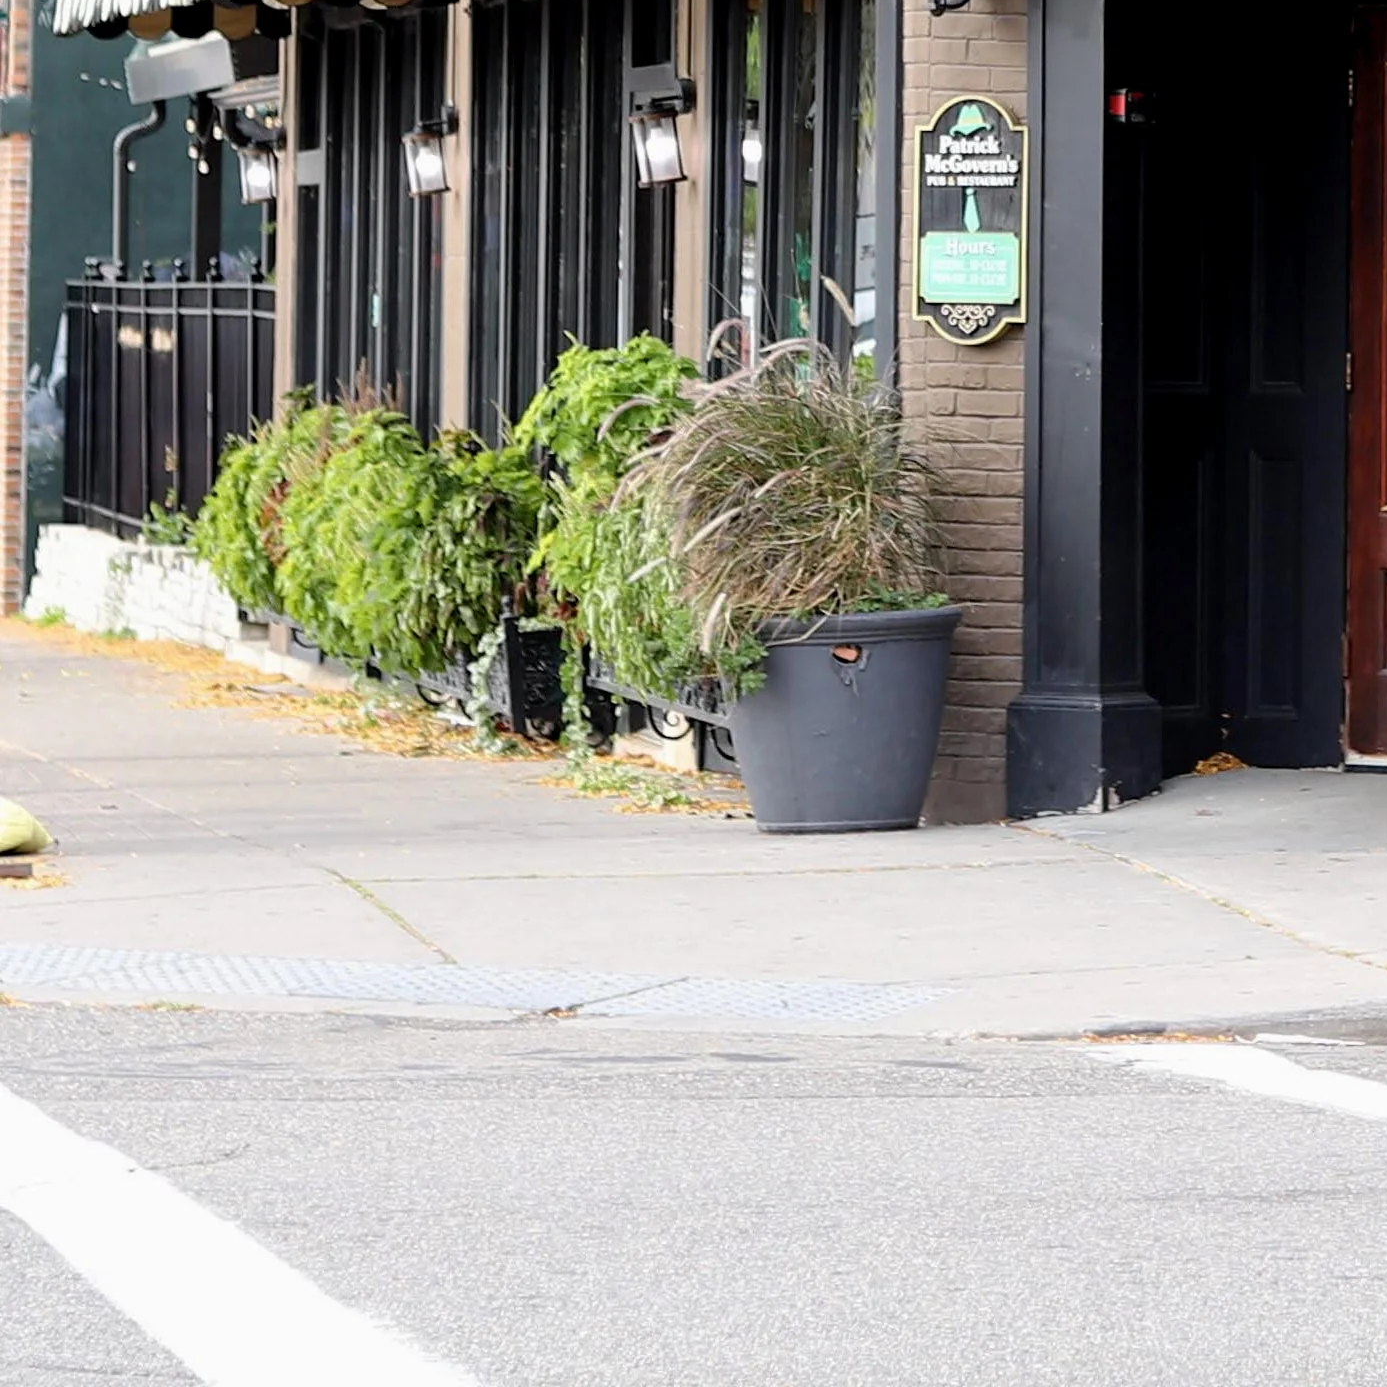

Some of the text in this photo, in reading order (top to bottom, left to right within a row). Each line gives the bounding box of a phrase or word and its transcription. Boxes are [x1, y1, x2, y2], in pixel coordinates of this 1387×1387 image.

[938, 135, 1001, 154] Patrick
[924, 154, 1020, 174] McGovern's
[944, 237, 997, 256] Hours
